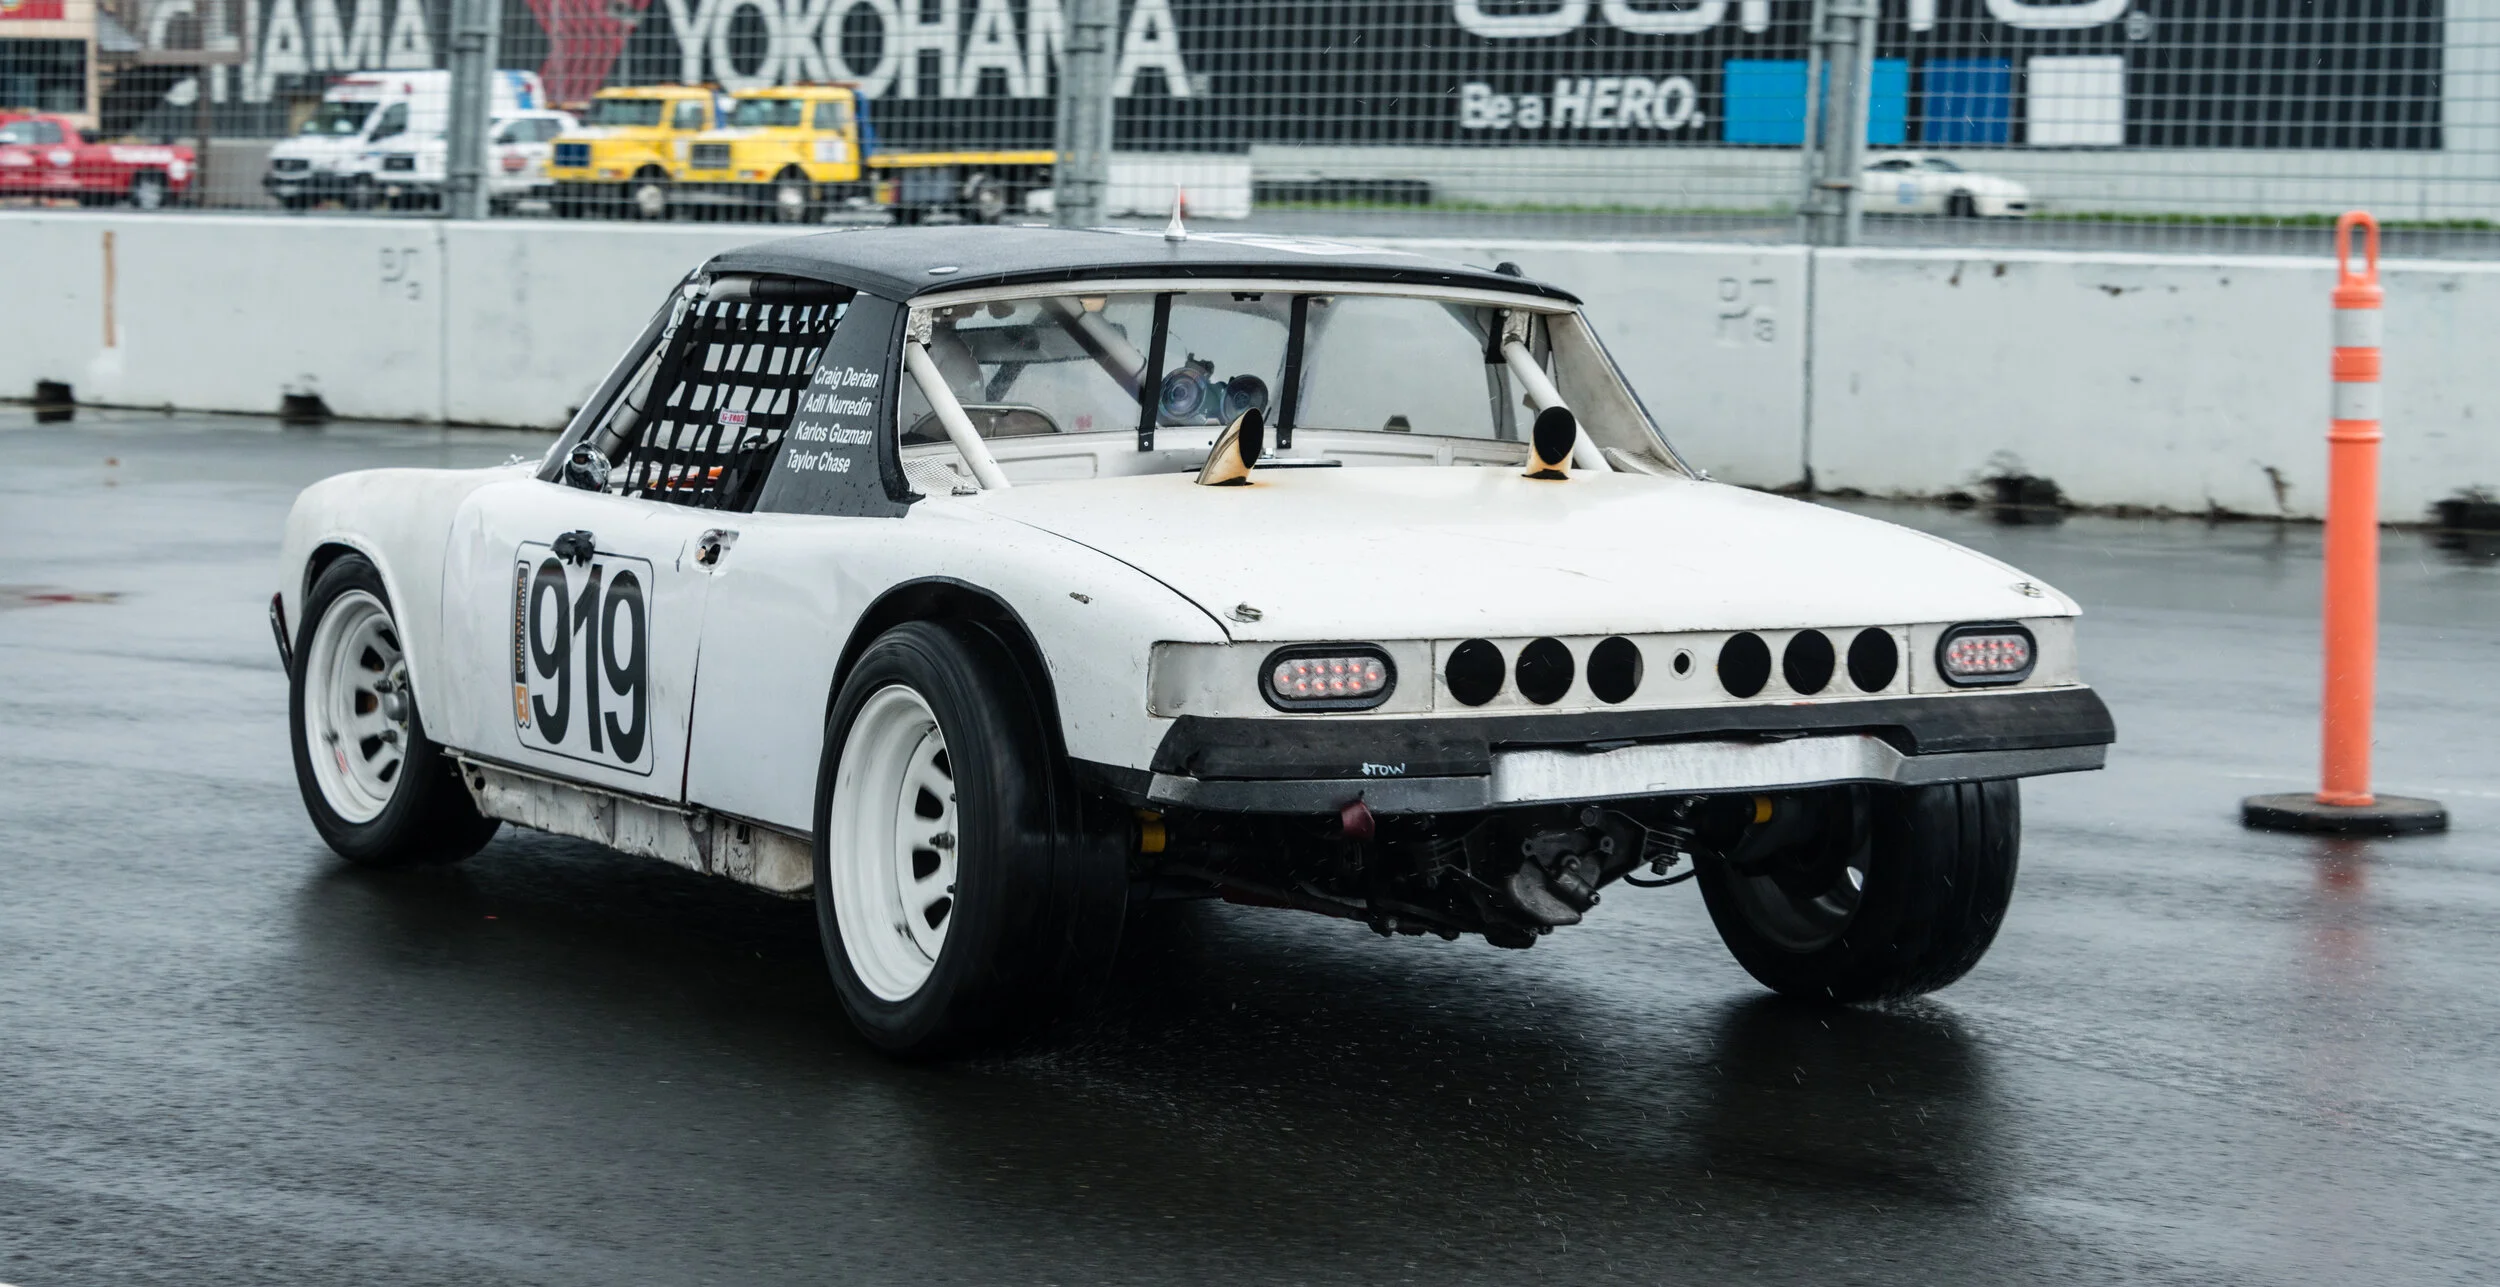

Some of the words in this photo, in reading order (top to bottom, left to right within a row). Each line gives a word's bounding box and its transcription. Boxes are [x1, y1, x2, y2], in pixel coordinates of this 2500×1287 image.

[1461, 82, 1514, 129] Be
[1517, 94, 1545, 129] a
[1551, 76, 1705, 130] HERO.
[814, 365, 842, 390] Craig
[842, 367, 879, 388] Derian
[803, 393, 828, 414] Adli
[825, 394, 872, 416] Nurredin
[795, 421, 828, 441] Karlos
[829, 423, 873, 445] Guzman
[787, 449, 818, 473] Taylor
[818, 451, 851, 473] Chase
[529, 557, 647, 763] 919
[1369, 763, 1406, 776] TOW
